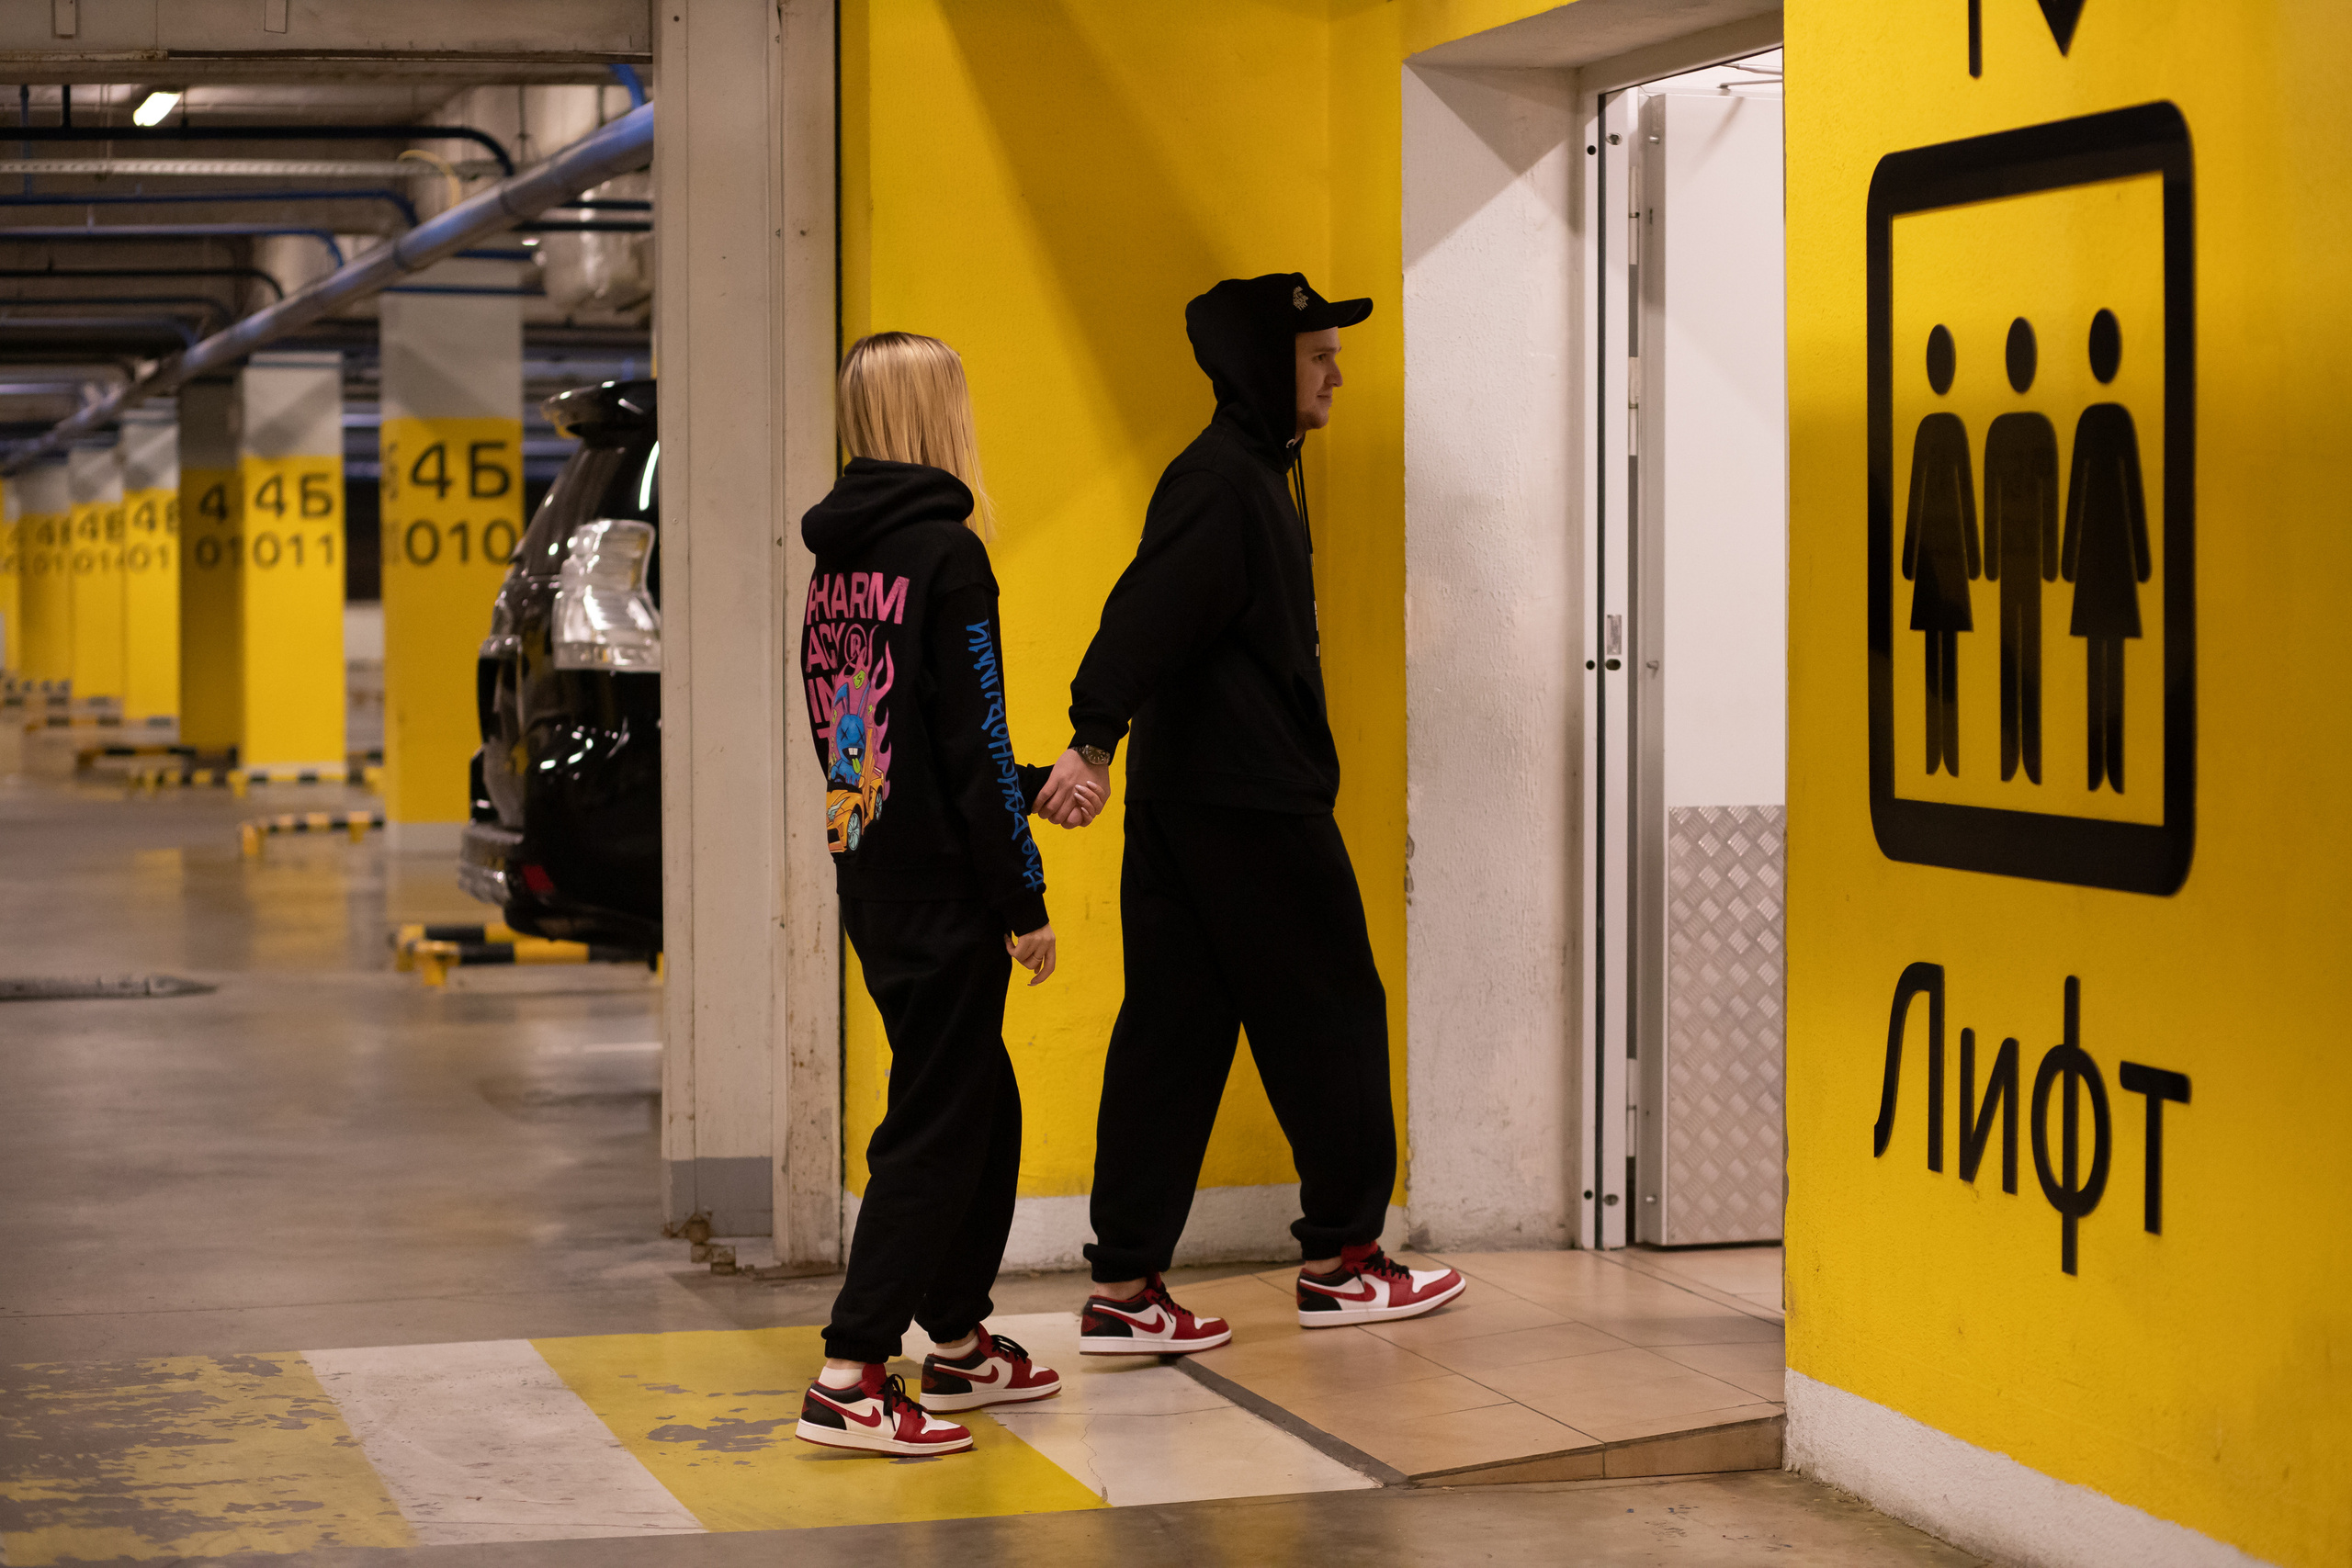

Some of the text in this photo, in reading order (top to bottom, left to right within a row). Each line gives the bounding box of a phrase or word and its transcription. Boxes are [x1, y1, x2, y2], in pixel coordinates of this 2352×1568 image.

[410, 439, 512, 501] 4Б
[254, 473, 334, 519] 4Б
[252, 531, 334, 570] 011
[404, 518, 517, 567] 010
[1873, 961, 2192, 1277] Лифт
